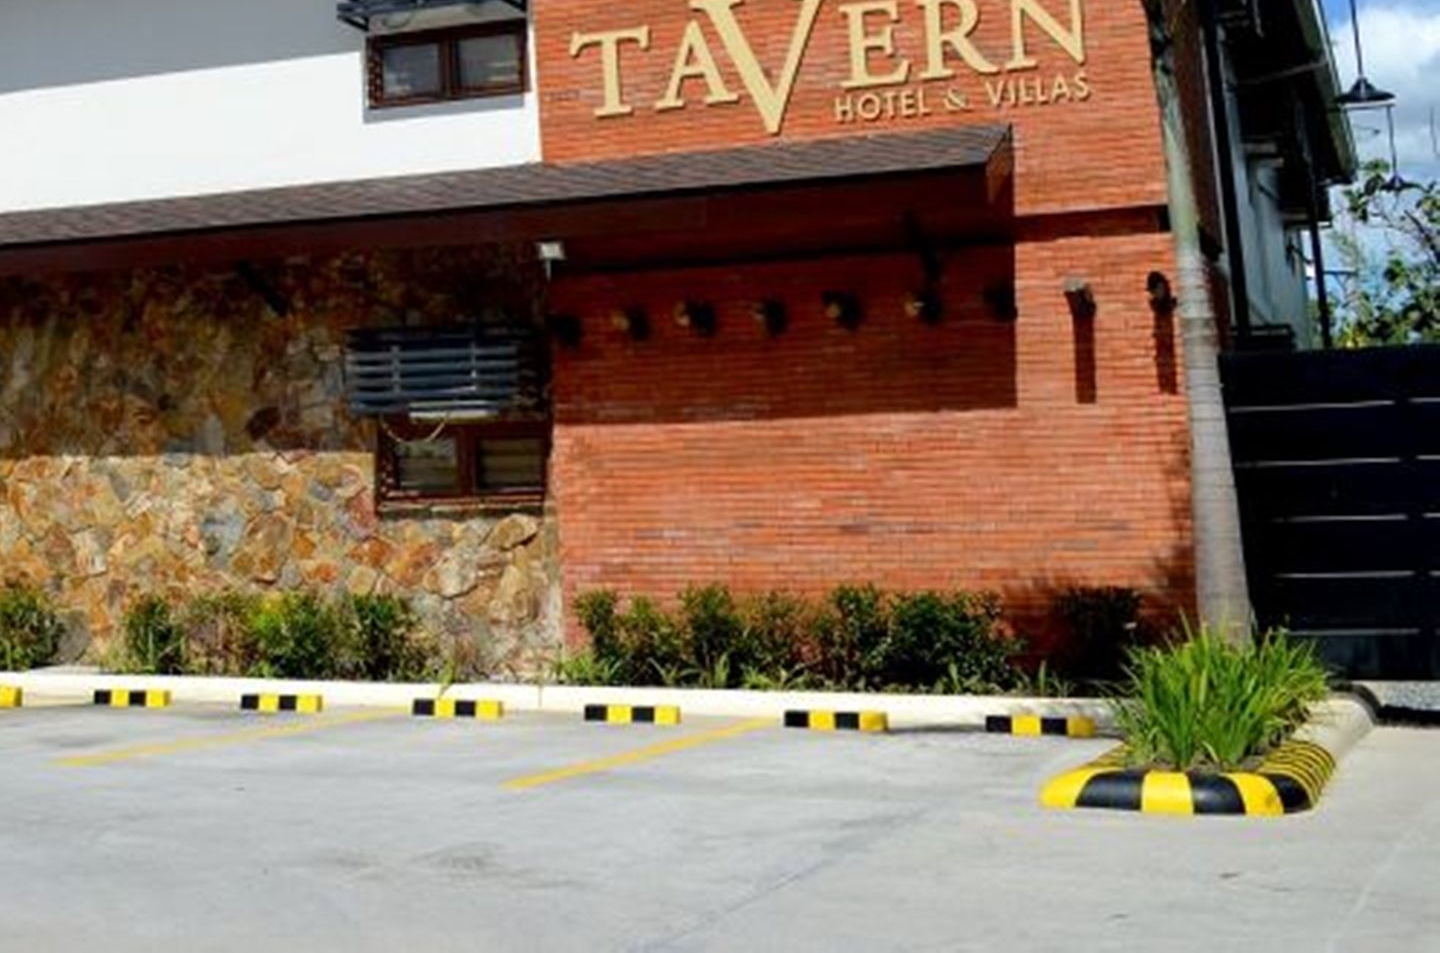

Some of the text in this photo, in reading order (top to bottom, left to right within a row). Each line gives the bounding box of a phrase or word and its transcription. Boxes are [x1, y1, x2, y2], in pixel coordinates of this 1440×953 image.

[834, 72, 1091, 122] HOTEL & VILLAS
